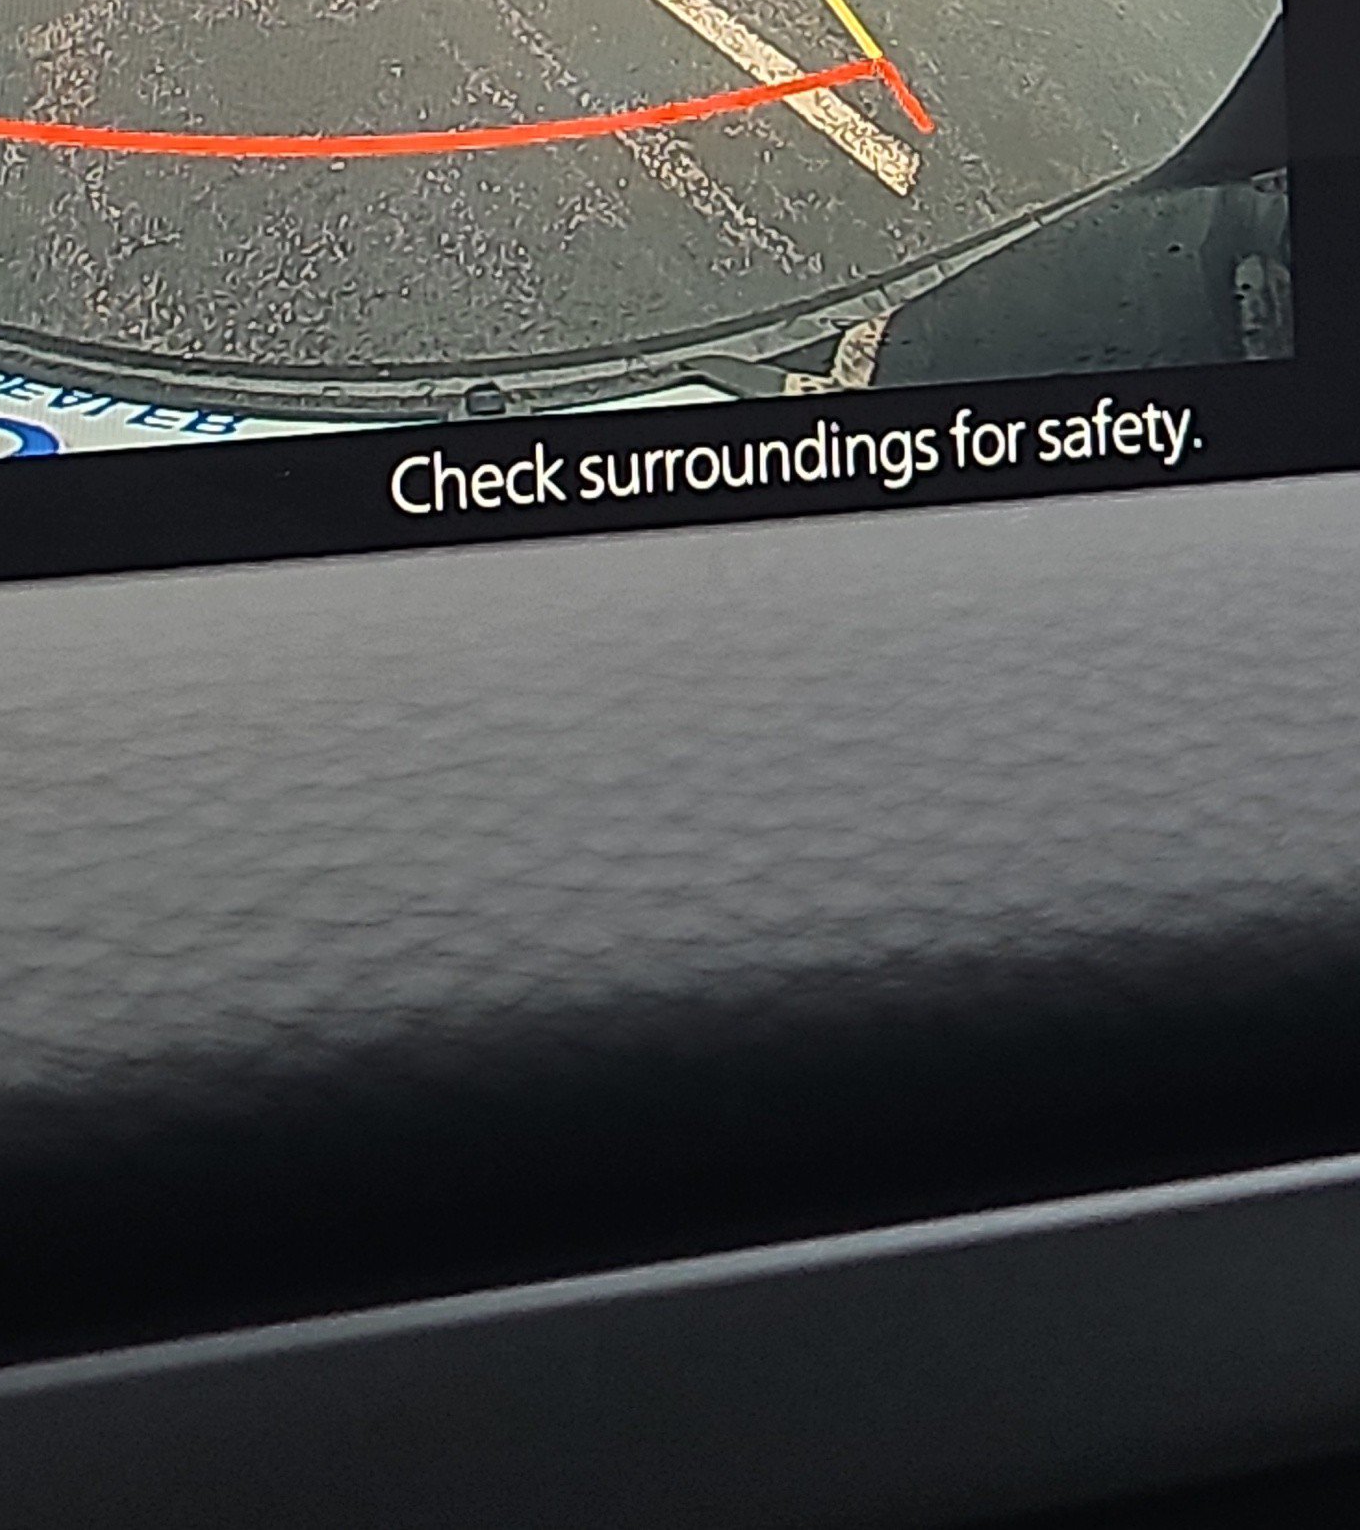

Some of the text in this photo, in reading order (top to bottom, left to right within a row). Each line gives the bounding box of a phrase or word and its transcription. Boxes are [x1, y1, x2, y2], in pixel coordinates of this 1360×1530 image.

[390, 397, 1204, 513] Check surroundings for safety.
